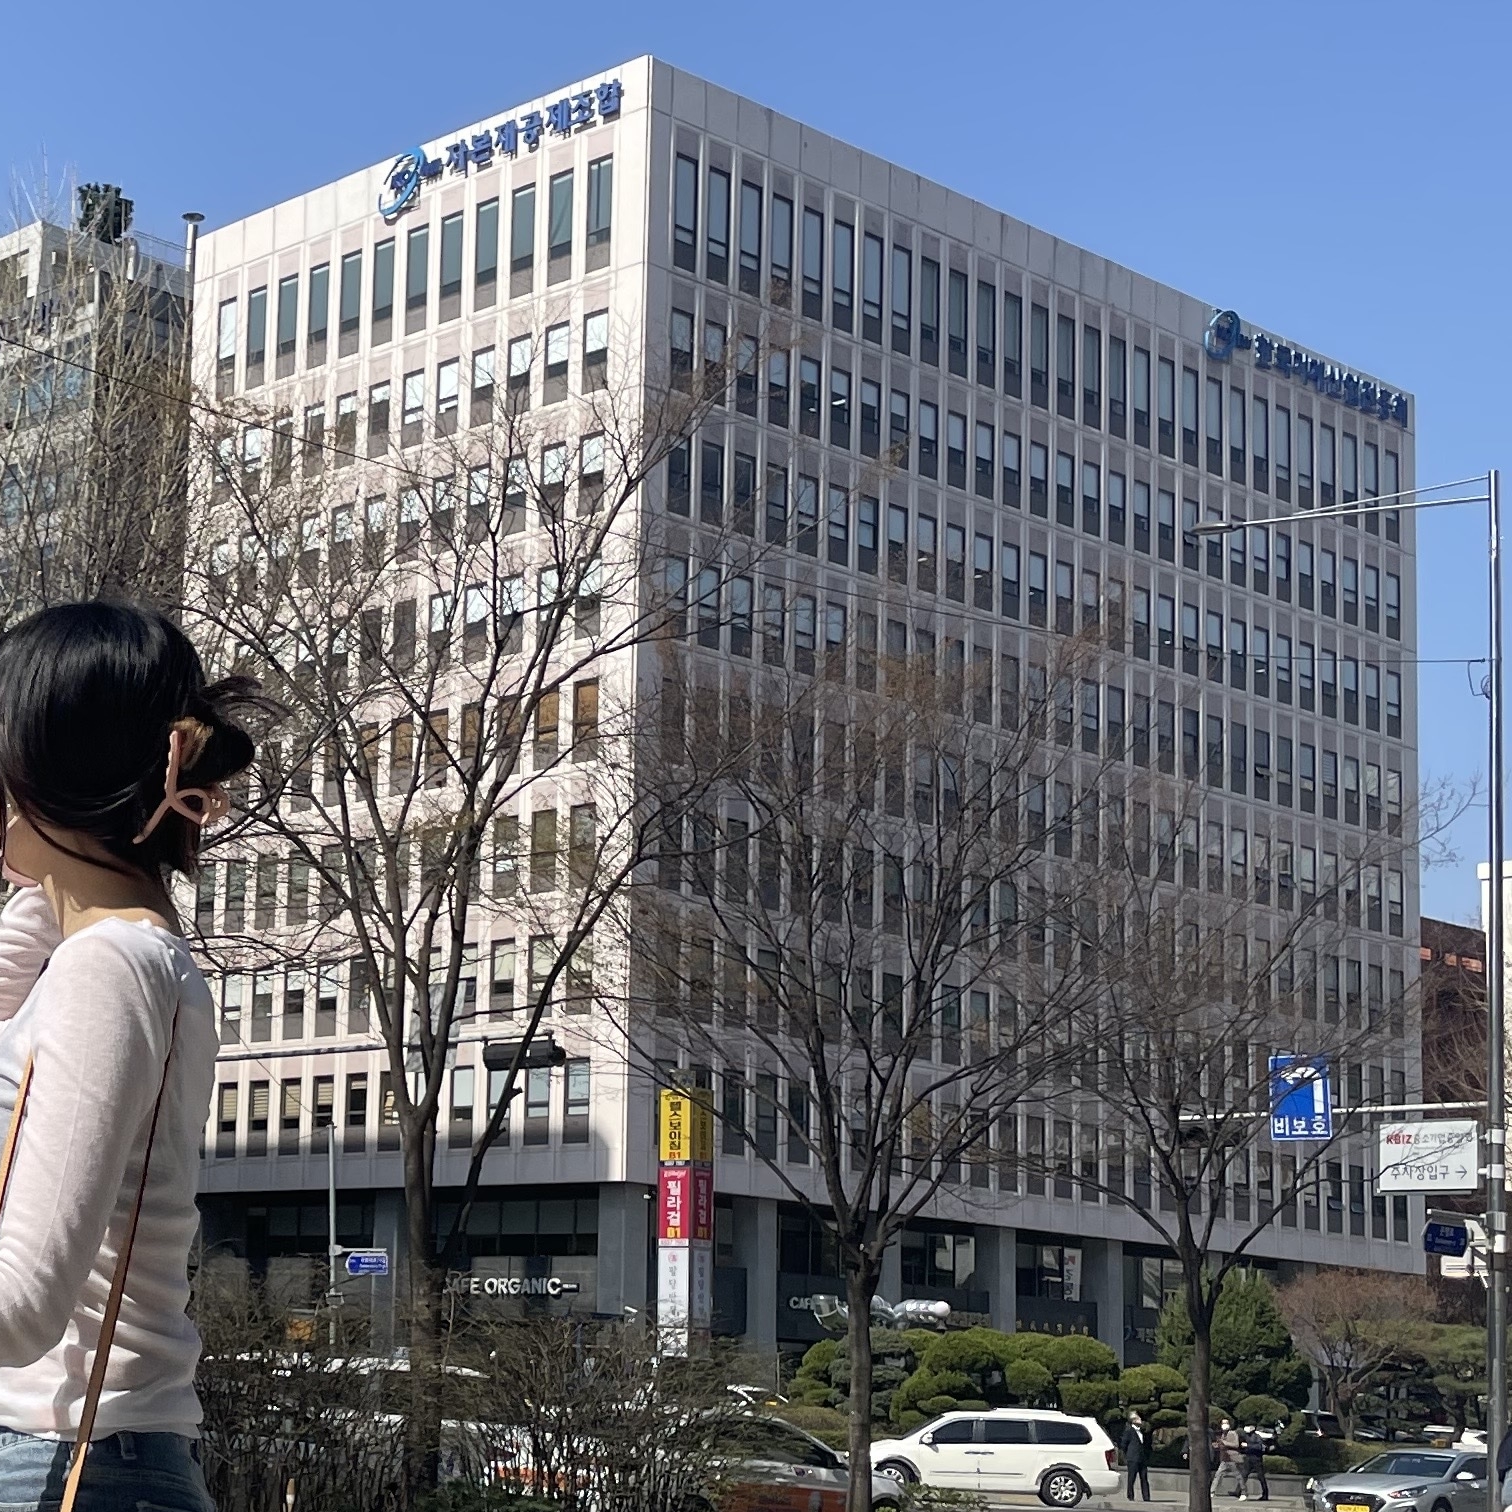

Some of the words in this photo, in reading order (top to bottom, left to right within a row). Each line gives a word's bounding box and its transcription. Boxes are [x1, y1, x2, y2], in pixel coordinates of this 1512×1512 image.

[445, 78, 623, 172] 자본재공제조합
[1274, 1115, 1328, 1136] 비보호
[1386, 1133, 1412, 1145] KBIZ
[1391, 1165, 1449, 1180] 주차장입구
[667, 1180, 682, 1227] 필라걸
[484, 1277, 562, 1294] ORGANIC
